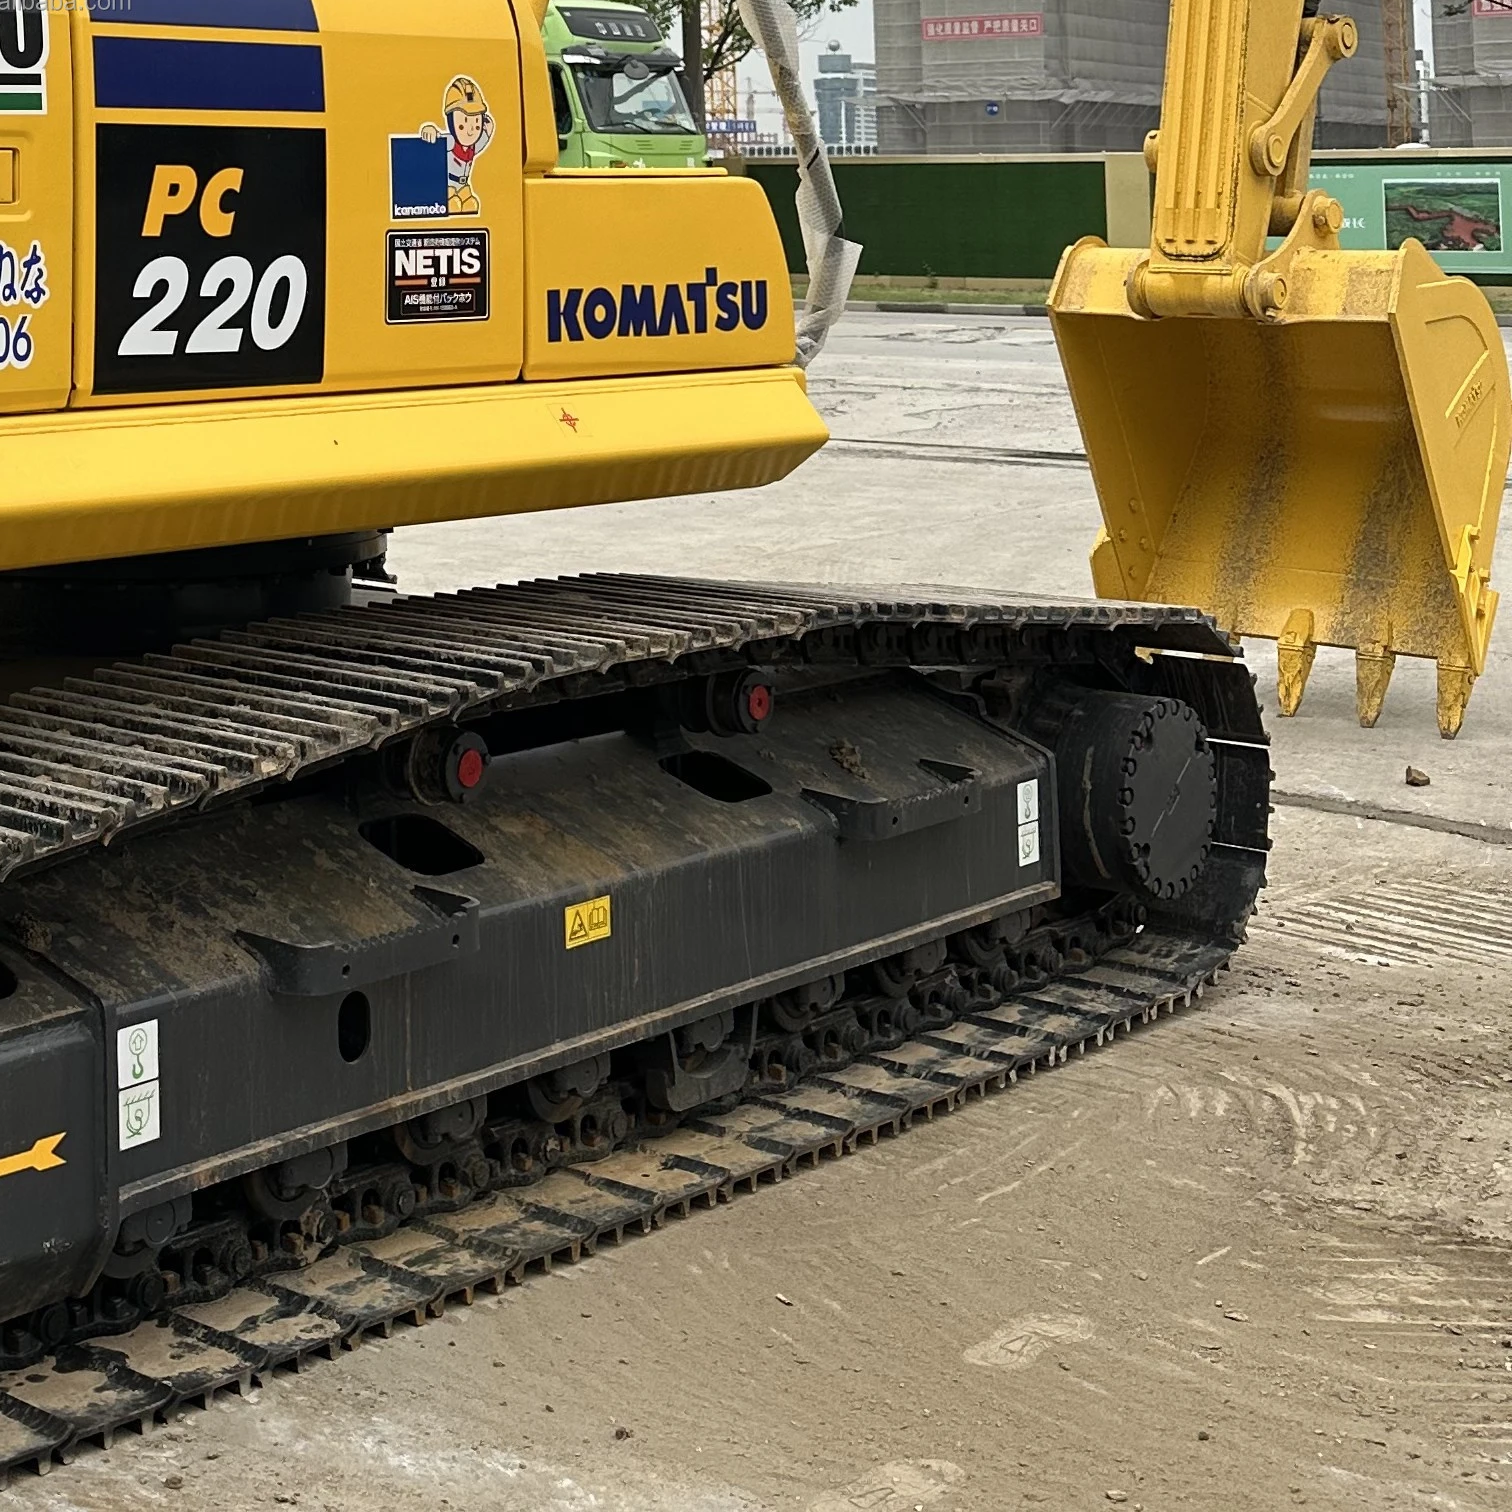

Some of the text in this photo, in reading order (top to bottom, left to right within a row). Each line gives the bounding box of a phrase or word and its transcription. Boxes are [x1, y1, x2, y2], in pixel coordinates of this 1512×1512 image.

[140, 164, 245, 237] PC
[394, 202, 447, 216] kanamoto
[394, 247, 481, 276] NETIS
[117, 254, 308, 356] 220
[546, 266, 768, 343] KOMATSU
